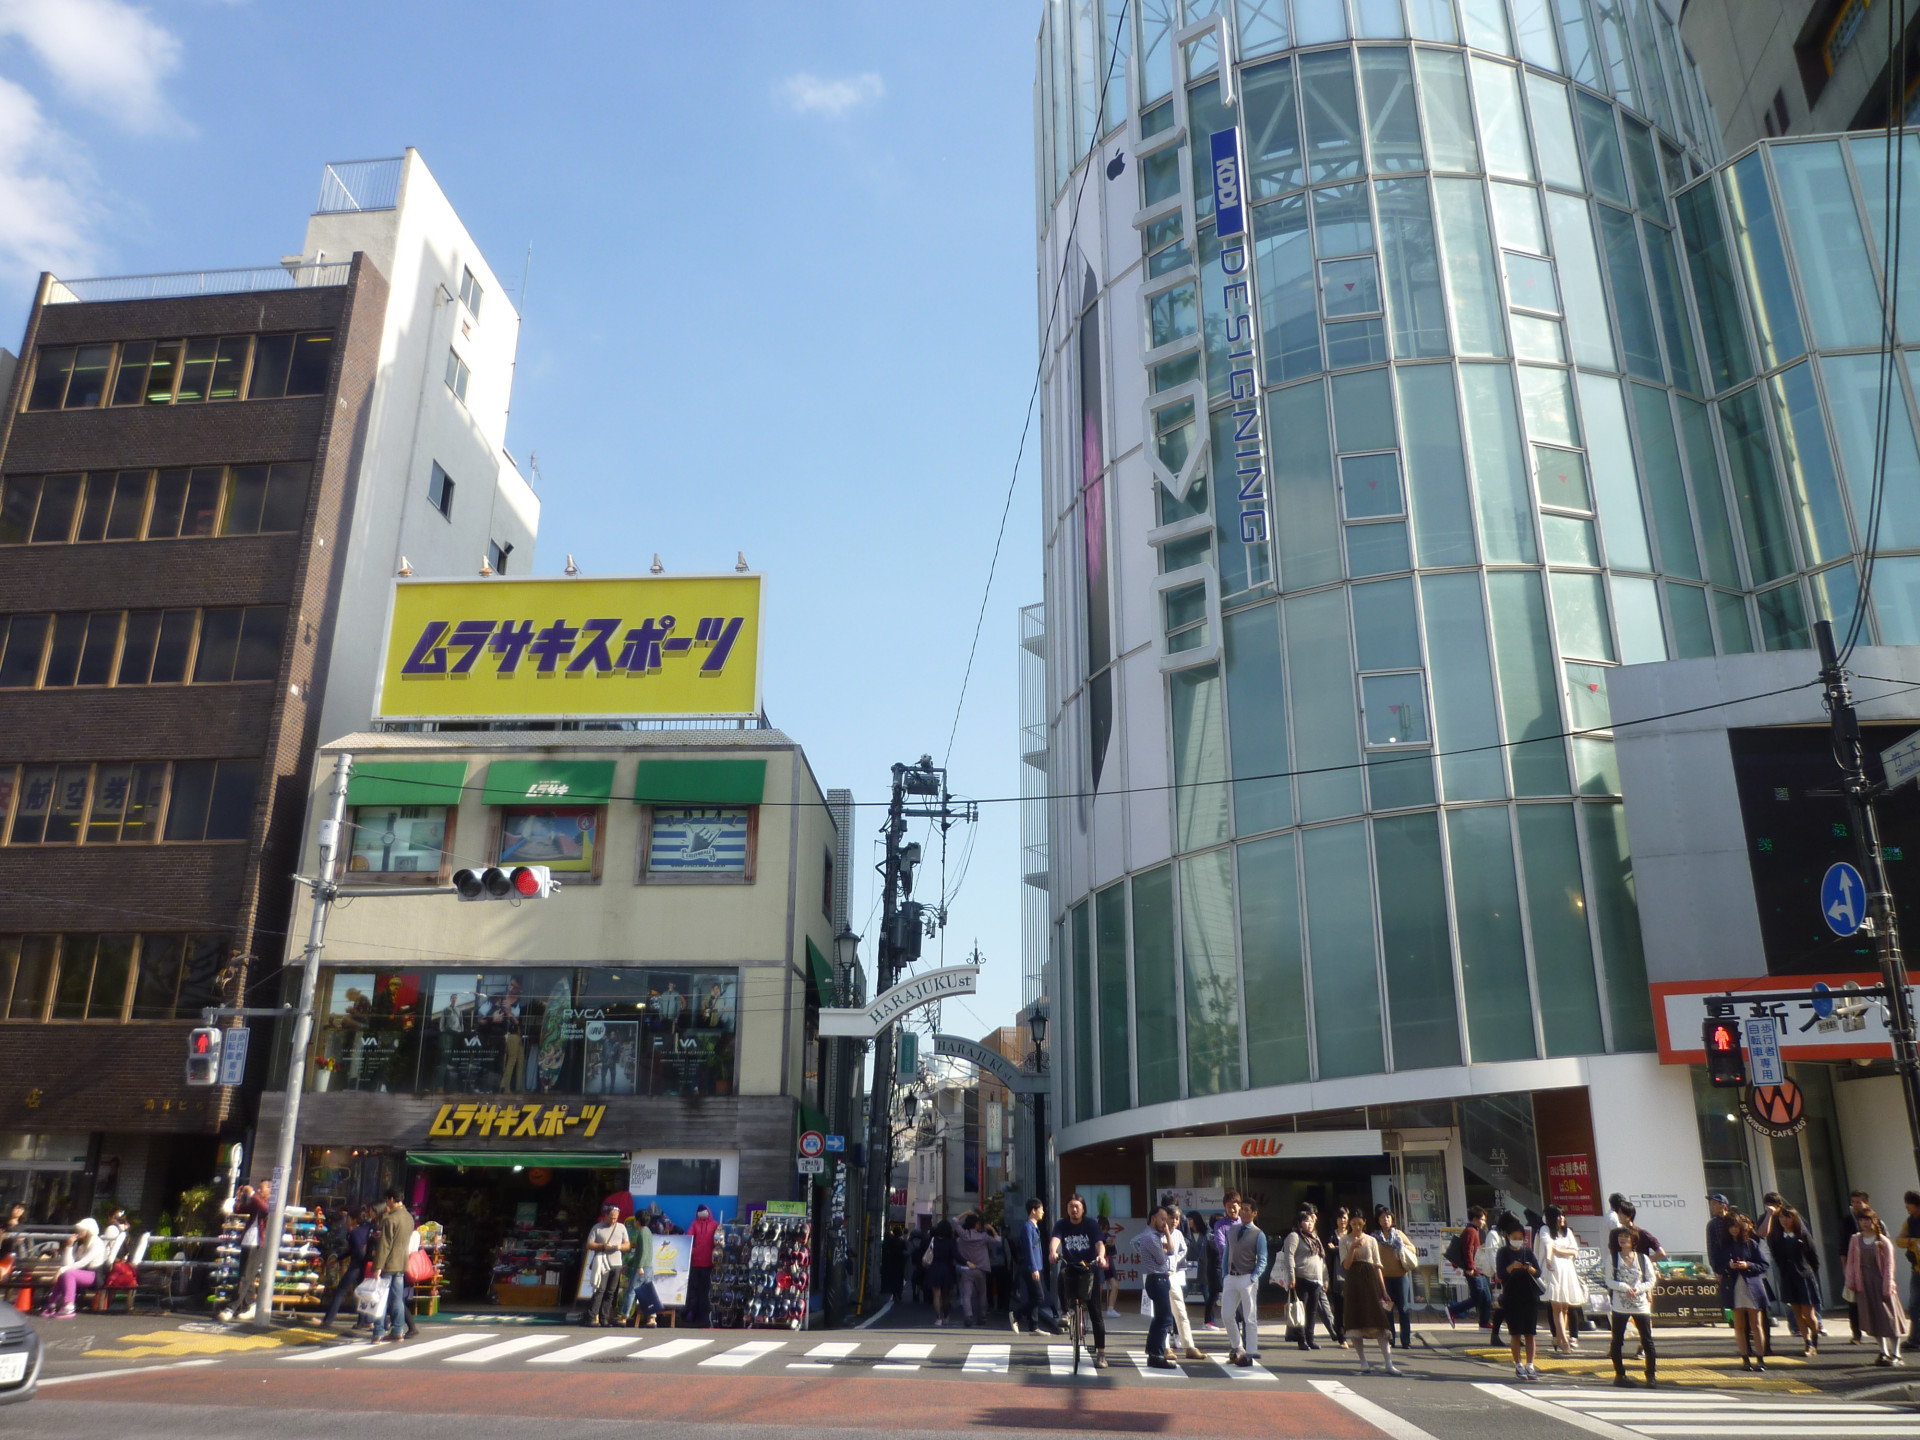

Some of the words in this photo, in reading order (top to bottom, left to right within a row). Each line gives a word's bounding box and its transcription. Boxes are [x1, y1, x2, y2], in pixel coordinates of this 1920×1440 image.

[1215, 155, 1239, 211] KDDI
[1220, 245, 1269, 545] DESIGNING
[400, 614, 745, 681] ムラサキスポーツ
[525, 784, 570, 798] ムラサキ
[563, 1008, 605, 1019] RVCA
[429, 1103, 606, 1136] ムラサキスポーツ
[1745, 1114, 1770, 1135] WIRED
[1771, 1128, 1793, 1137] CAFE
[1240, 1138, 1283, 1157] au
[1629, 1195, 1686, 1208] STUDIO
[1667, 1285, 1694, 1296] CAFE
[1678, 1307, 1690, 1317] 5F
